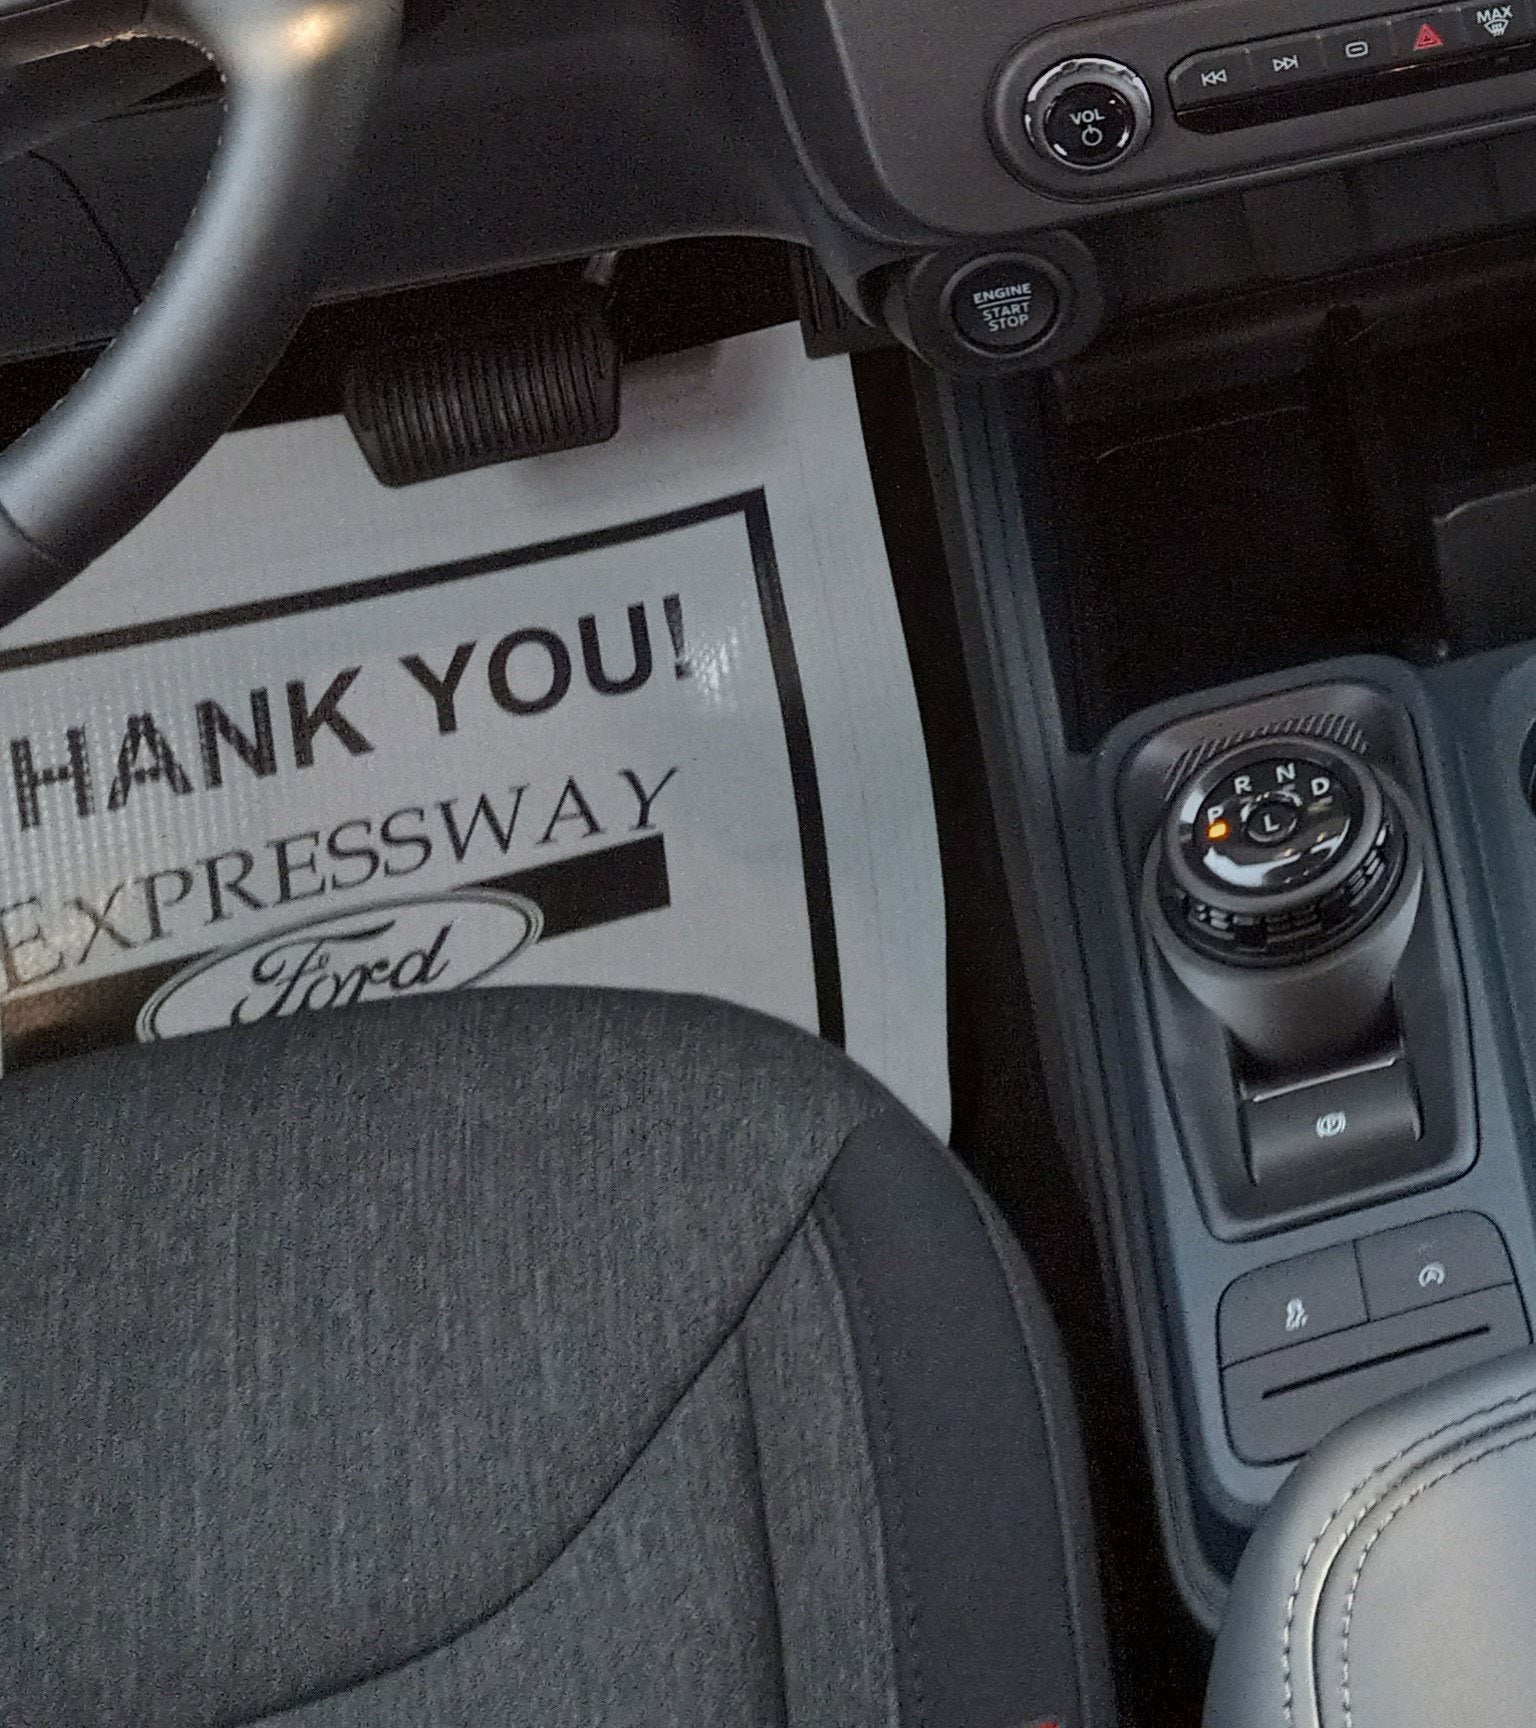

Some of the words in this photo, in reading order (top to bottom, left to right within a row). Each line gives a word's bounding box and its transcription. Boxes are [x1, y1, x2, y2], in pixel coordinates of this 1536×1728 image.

[1476, 6, 1513, 24] MAX
[1069, 109, 1106, 126] VOL
[973, 282, 1033, 304] ENGINE
[982, 301, 1031, 321] START
[988, 314, 1030, 332] STOP
[8, 665, 376, 832] HANK
[400, 592, 696, 737] YOU!
[1276, 762, 1297, 783] N
[1234, 775, 1252, 794] R
[1311, 777, 1330, 796] D
[1207, 805, 1224, 824] P
[1264, 813, 1280, 832] L
[0, 766, 681, 993] EXPRESSWAY
[230, 919, 455, 1028] Ford
